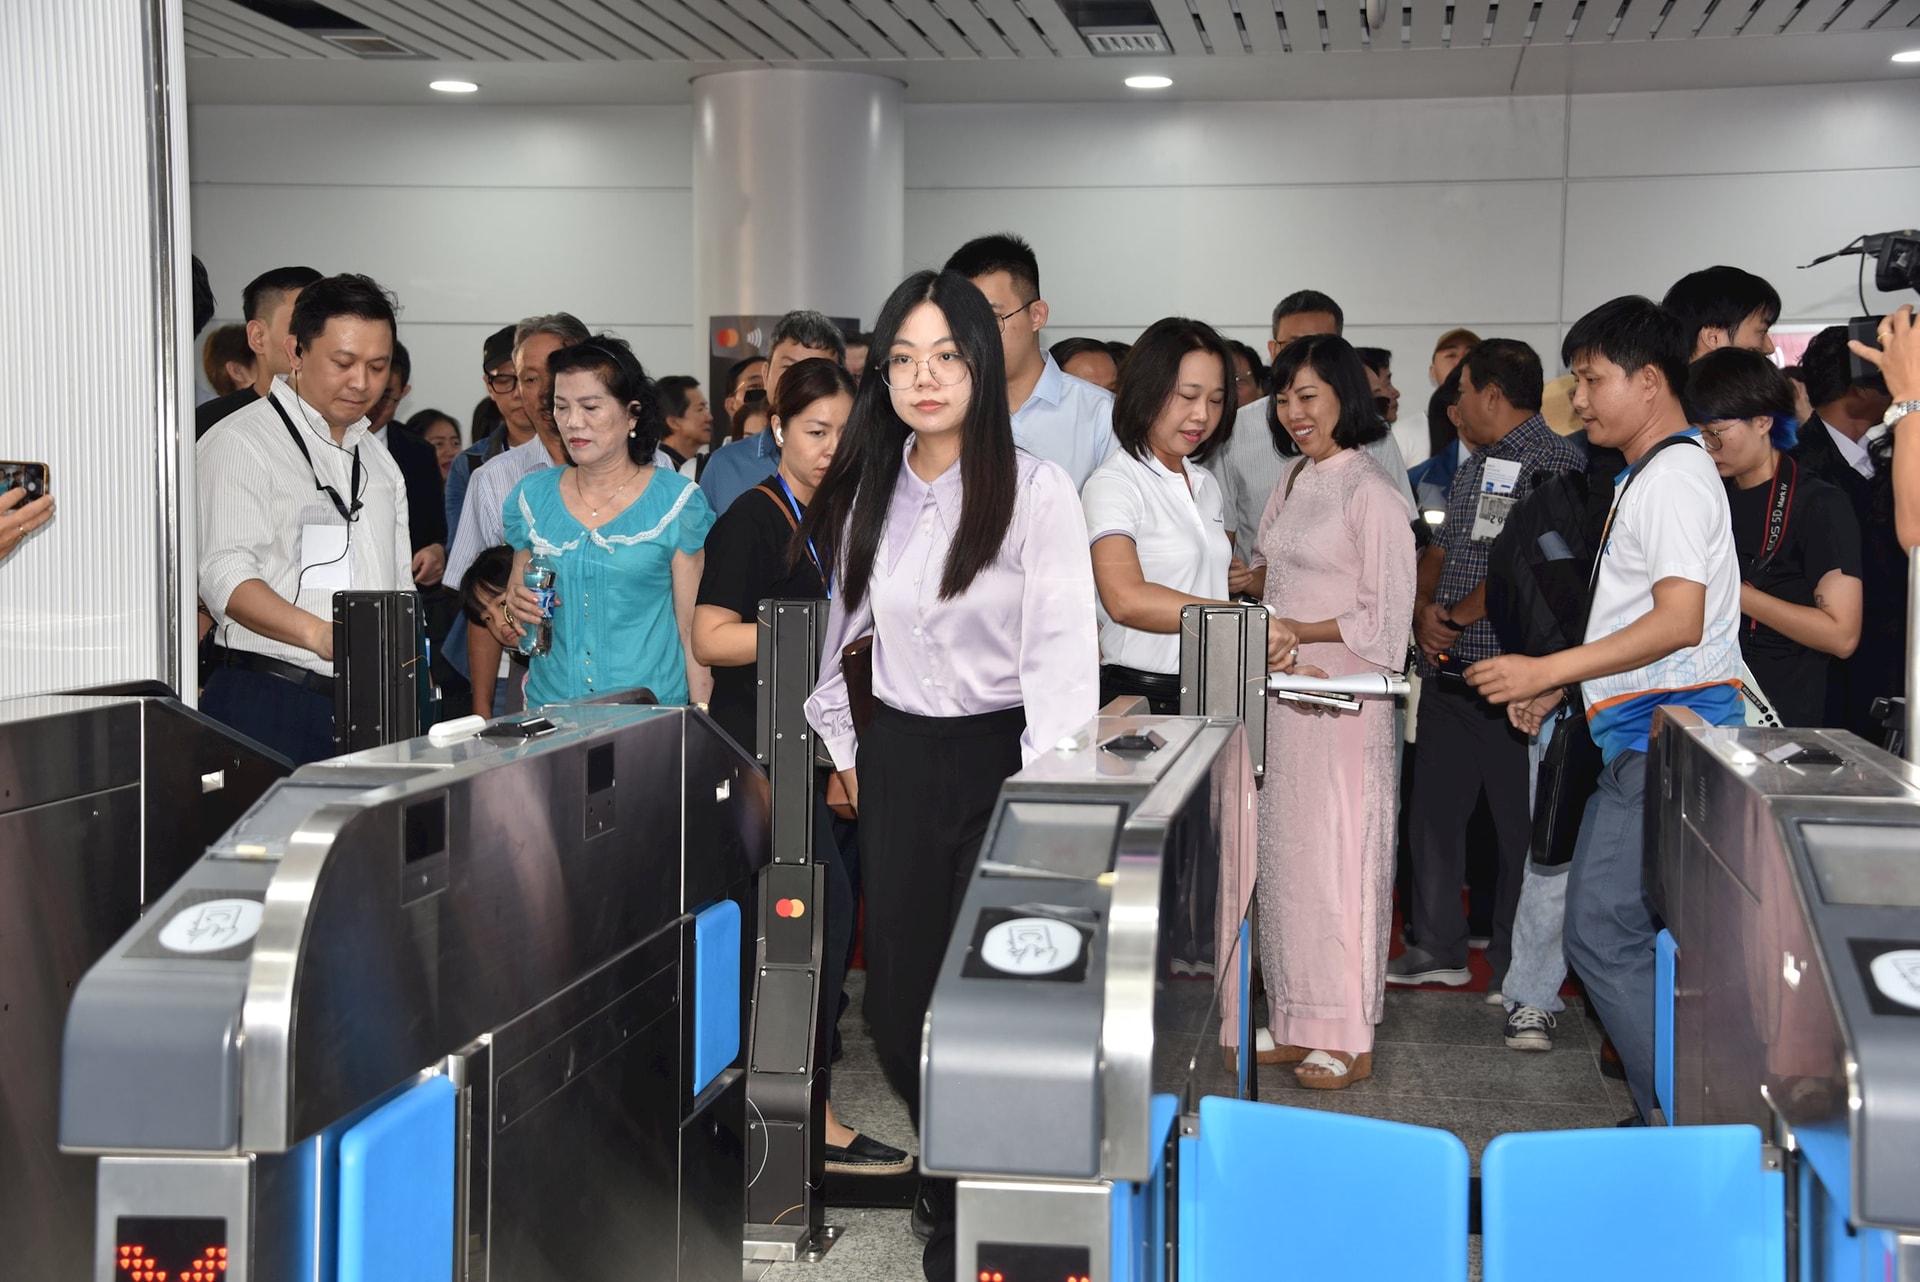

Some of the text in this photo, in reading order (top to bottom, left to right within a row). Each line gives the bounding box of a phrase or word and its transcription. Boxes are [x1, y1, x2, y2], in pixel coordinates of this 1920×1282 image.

[1777, 489, 1788, 508] Mark
[1771, 509, 1783, 523] 5D
[1766, 525, 1780, 551] EOS
